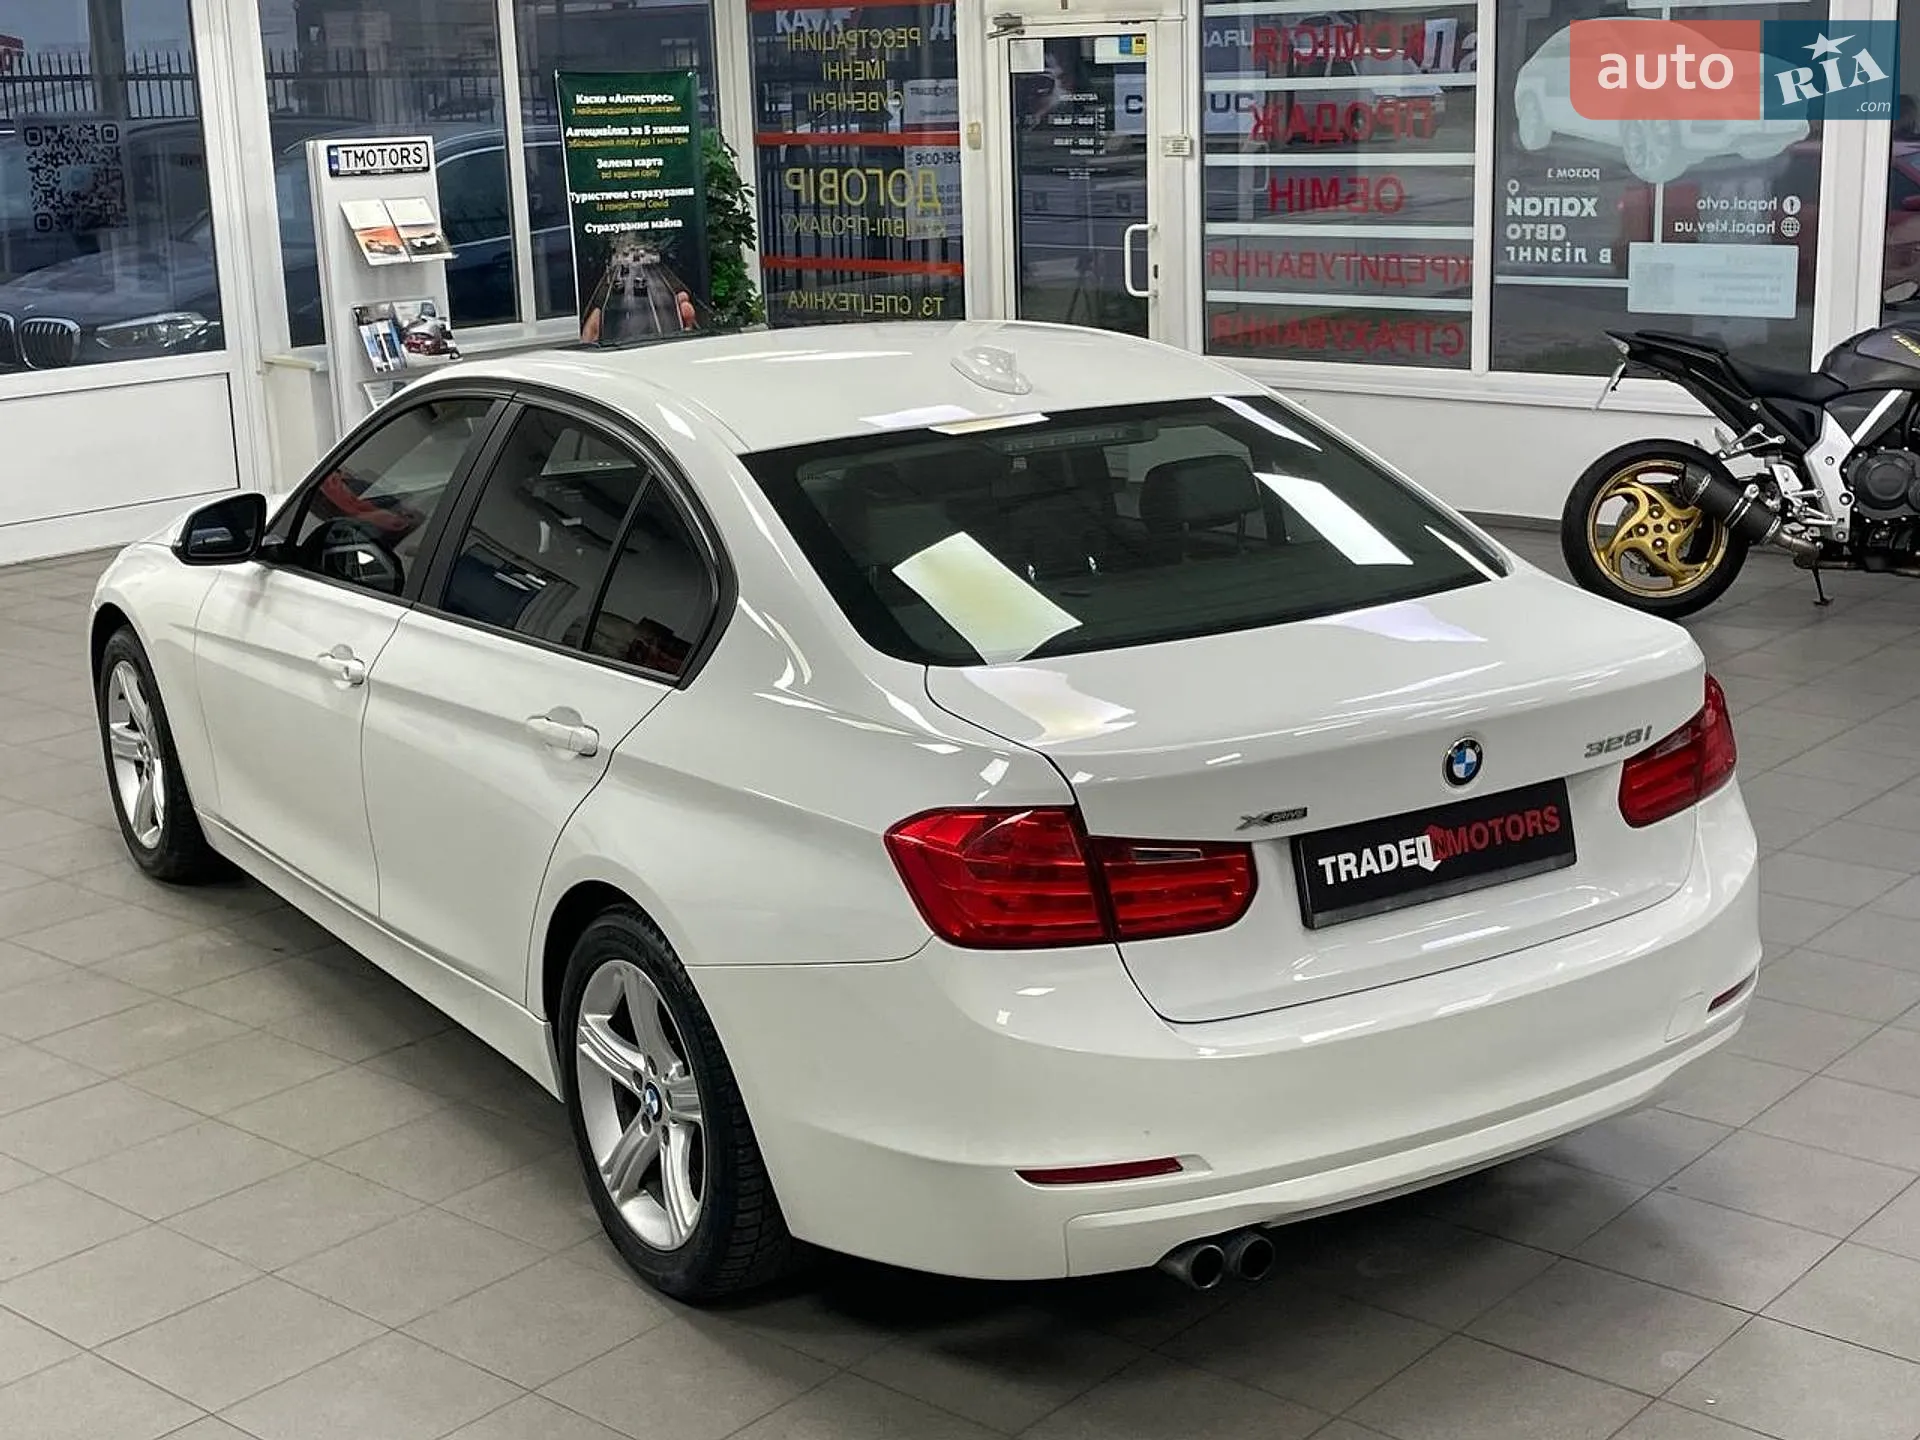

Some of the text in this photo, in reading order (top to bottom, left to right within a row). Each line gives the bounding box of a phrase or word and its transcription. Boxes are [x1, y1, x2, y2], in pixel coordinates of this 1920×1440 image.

[575, 94, 607, 105] Каско
[631, 126, 643, 135] за
[644, 124, 651, 135] 5
[342, 147, 424, 169] TMOTORS
[596, 157, 665, 169] Зелена карта
[584, 219, 650, 234] Страхування
